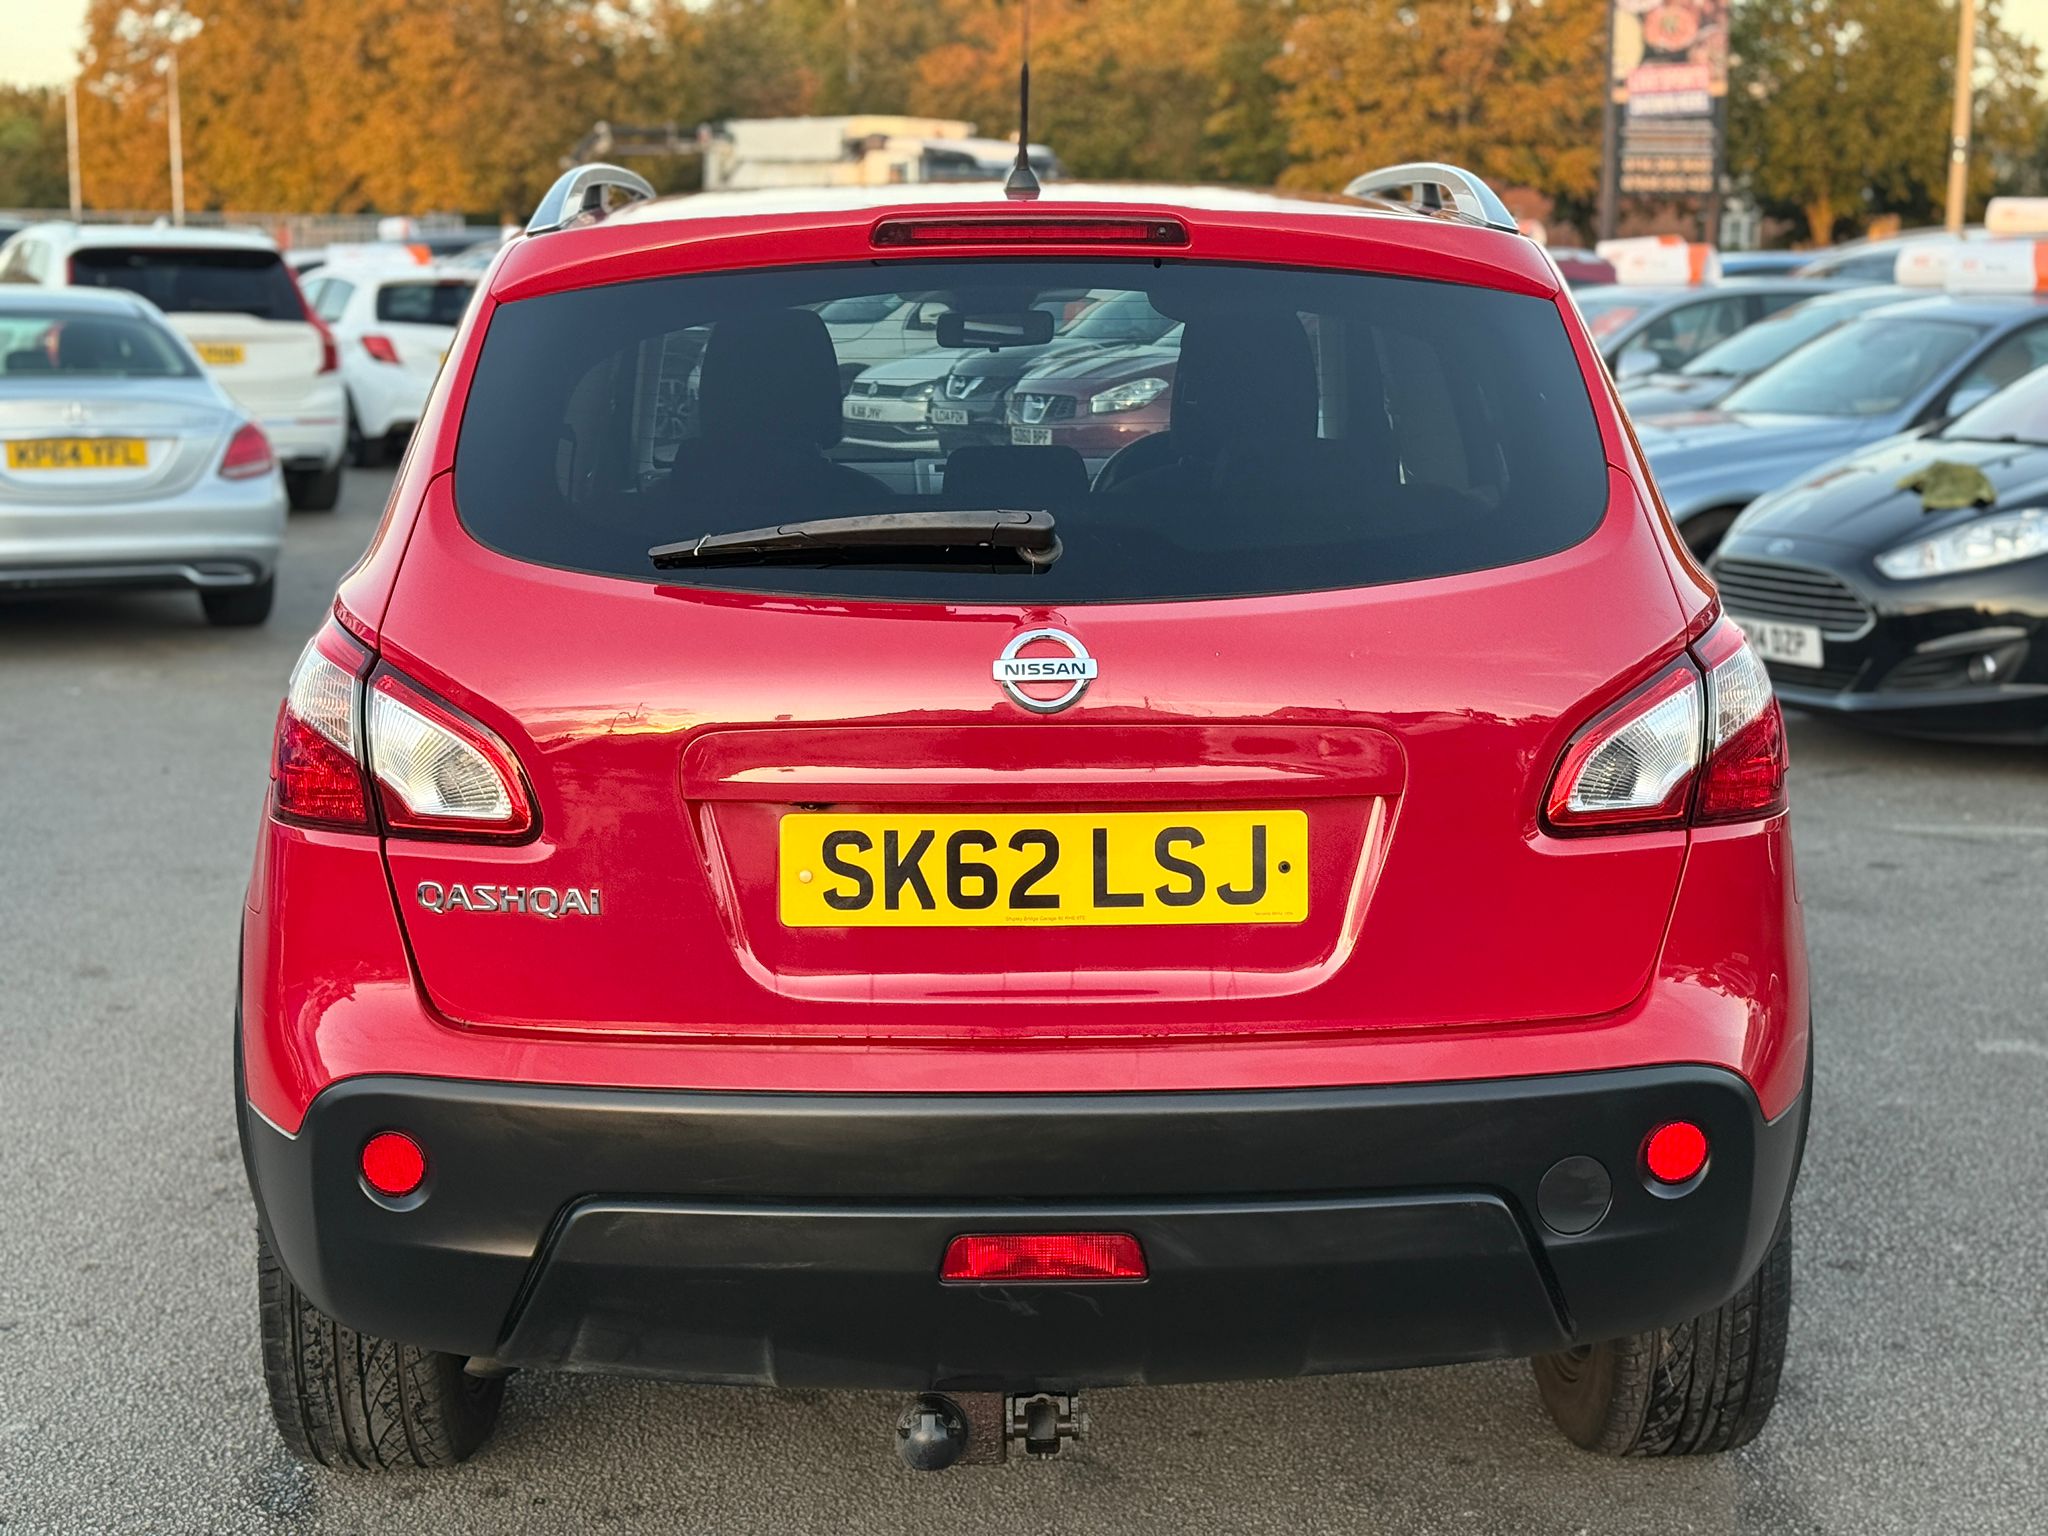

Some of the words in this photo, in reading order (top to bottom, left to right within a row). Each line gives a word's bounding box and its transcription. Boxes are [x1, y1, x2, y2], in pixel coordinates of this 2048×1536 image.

[1005, 663, 1086, 676] NISSAN
[822, 829, 1061, 911] SK62
[1092, 825, 1267, 907] LSJ
[417, 881, 601, 919] QASHQAI
